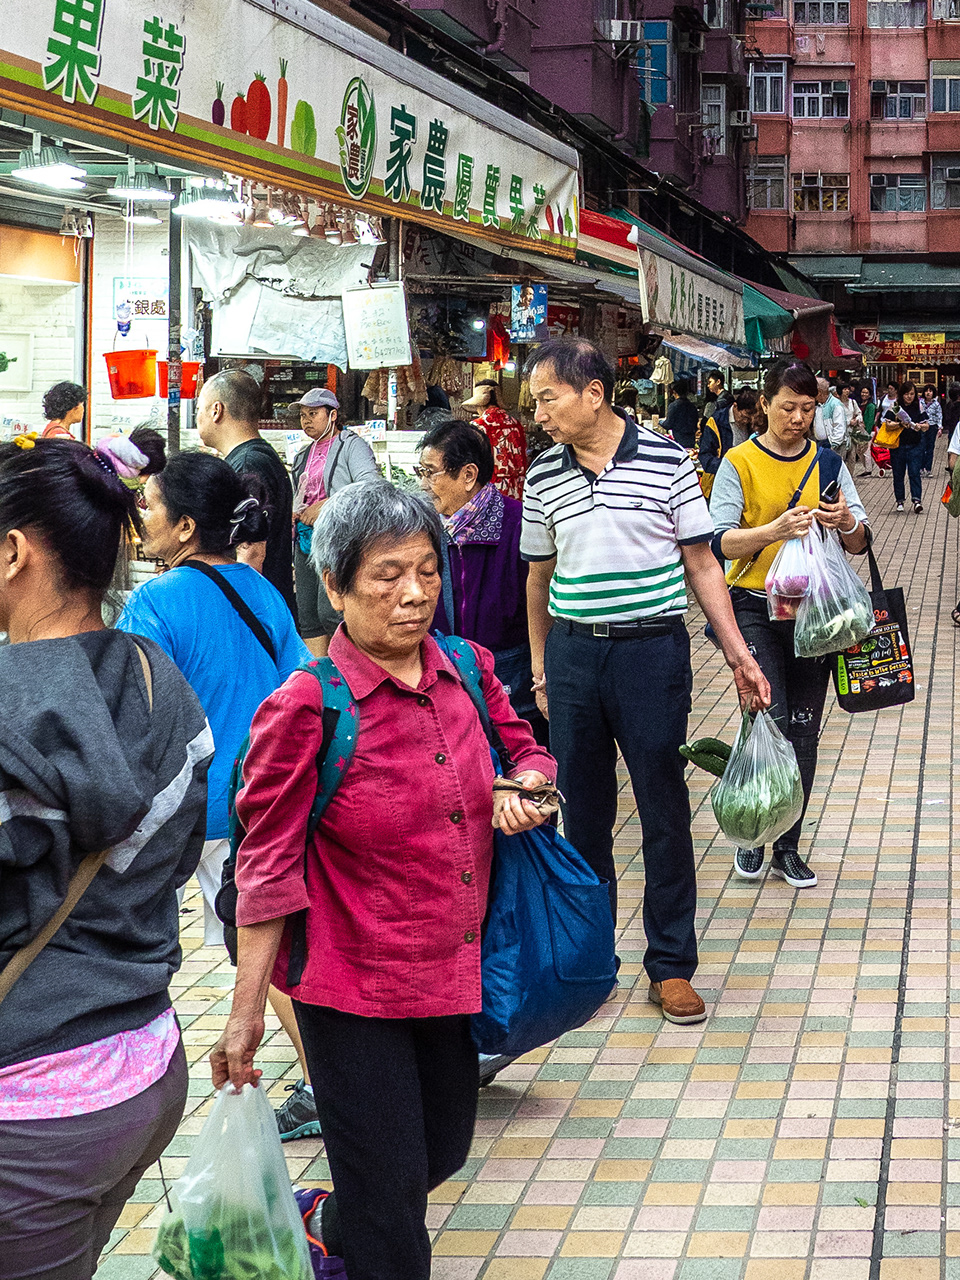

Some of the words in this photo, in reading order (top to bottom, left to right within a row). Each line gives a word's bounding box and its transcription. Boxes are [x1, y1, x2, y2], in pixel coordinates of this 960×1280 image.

[384, 104, 546, 240] 家農優質果菜
[127, 299, 166, 315] 銀處
